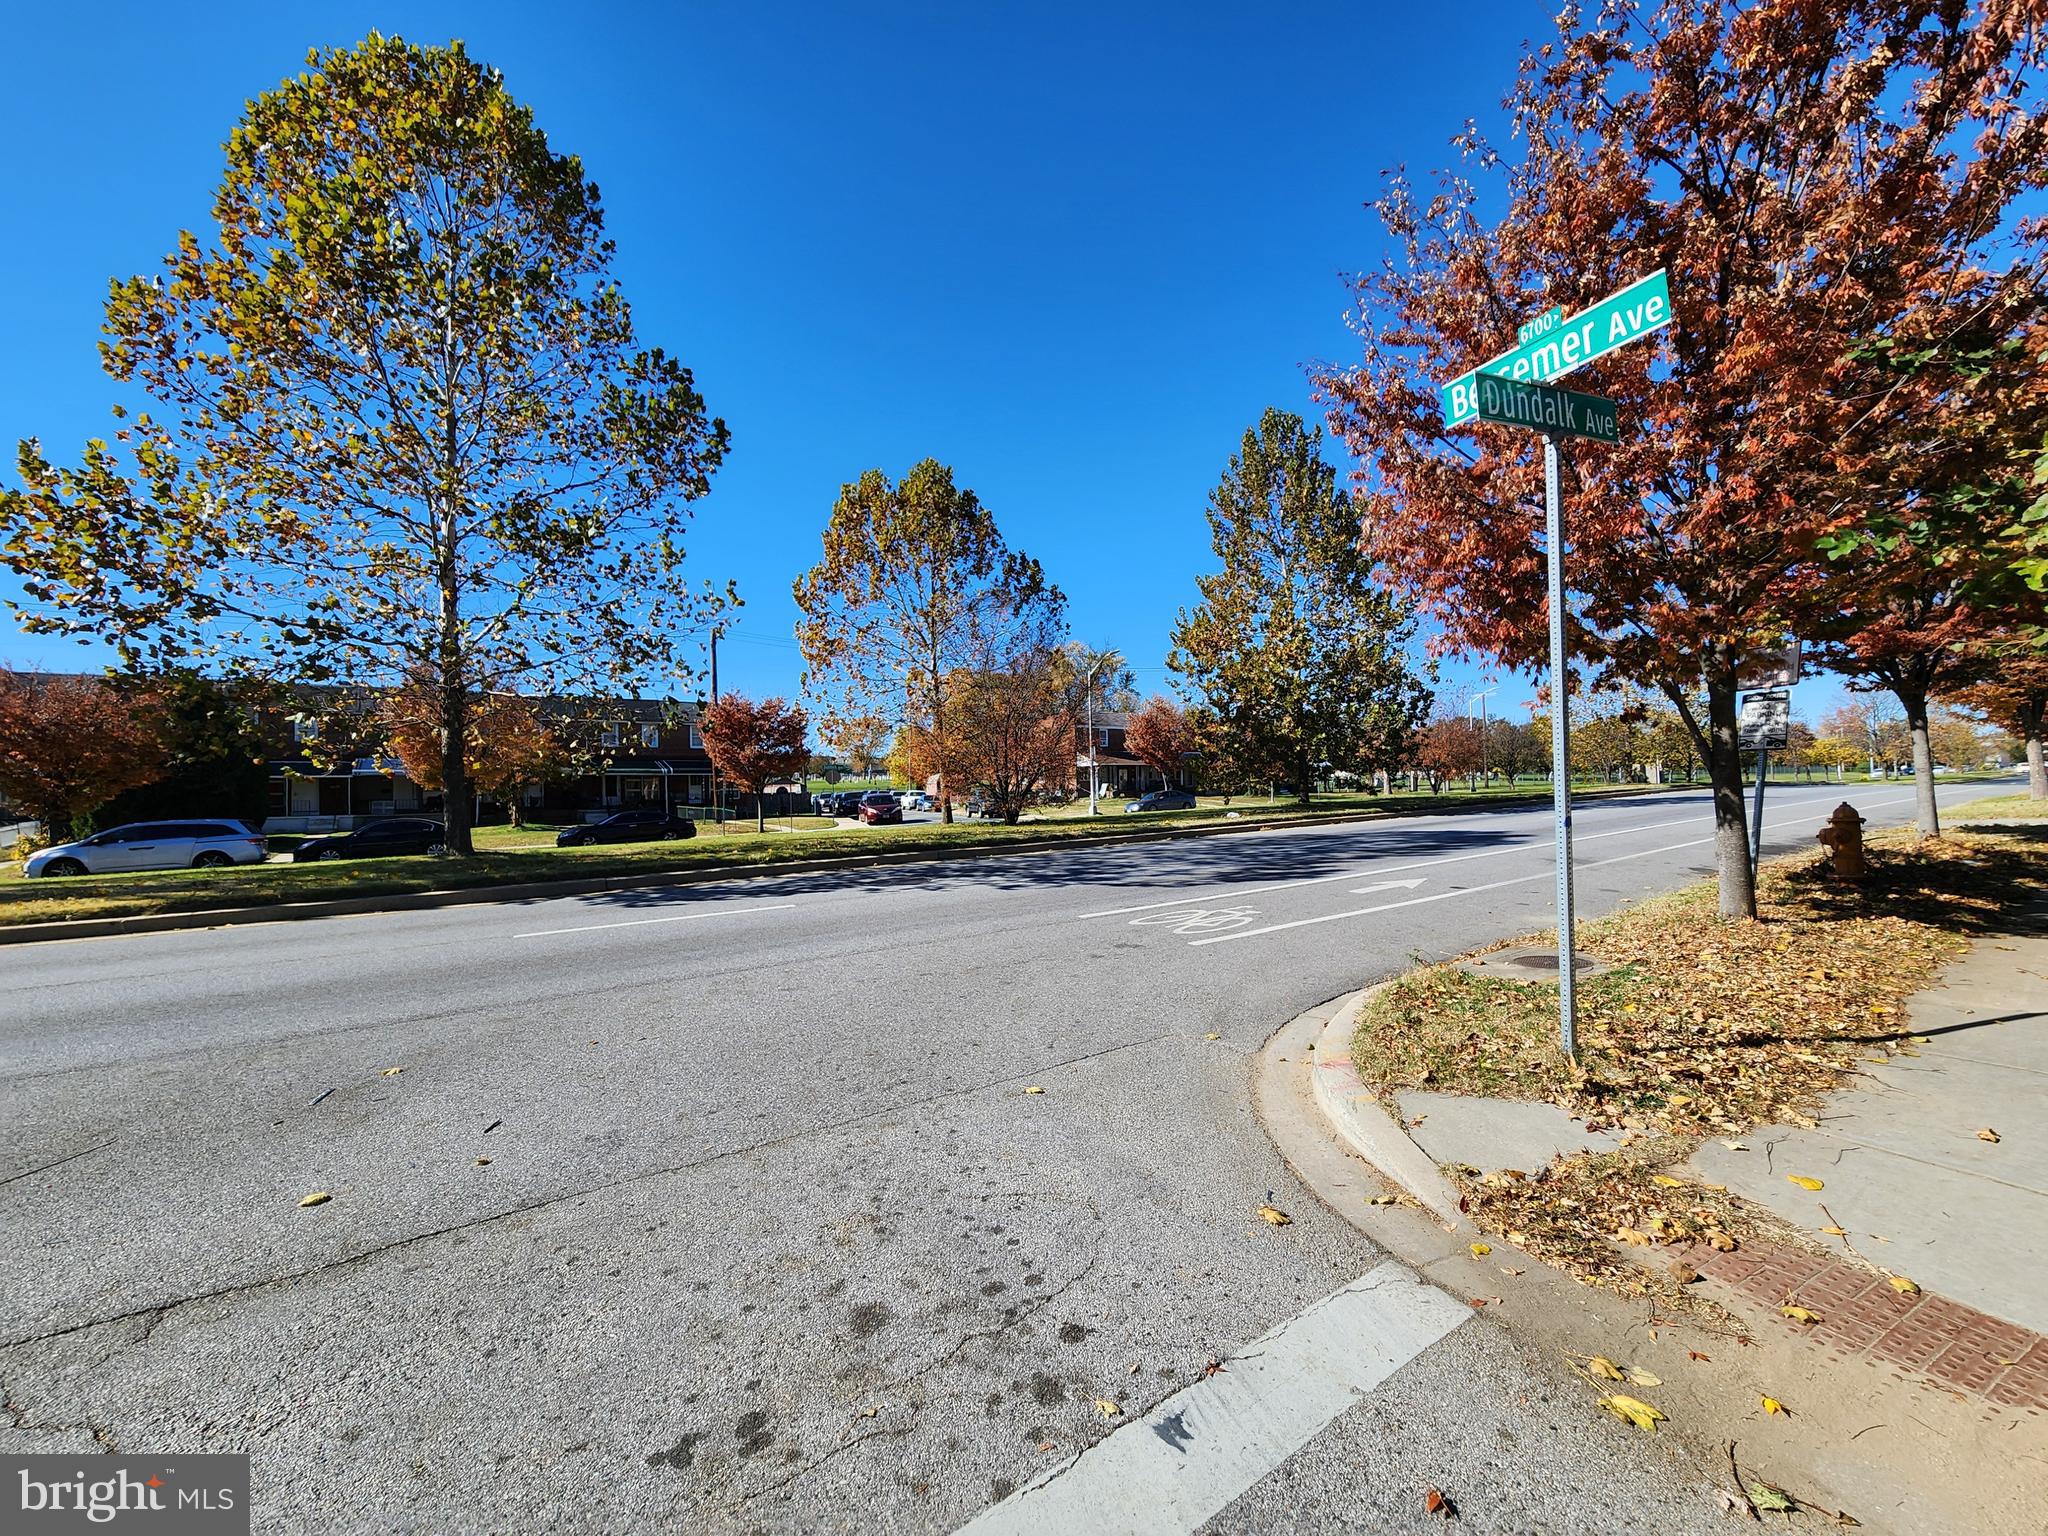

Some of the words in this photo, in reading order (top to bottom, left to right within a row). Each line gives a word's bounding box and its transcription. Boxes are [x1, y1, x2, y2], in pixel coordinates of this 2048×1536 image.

[1520, 313, 1553, 343] 6700
[1451, 321, 1595, 419] Beemer
[1608, 295, 1664, 344] Ave
[1485, 380, 1577, 429] Dundalk
[1586, 408, 1614, 436] Ave
